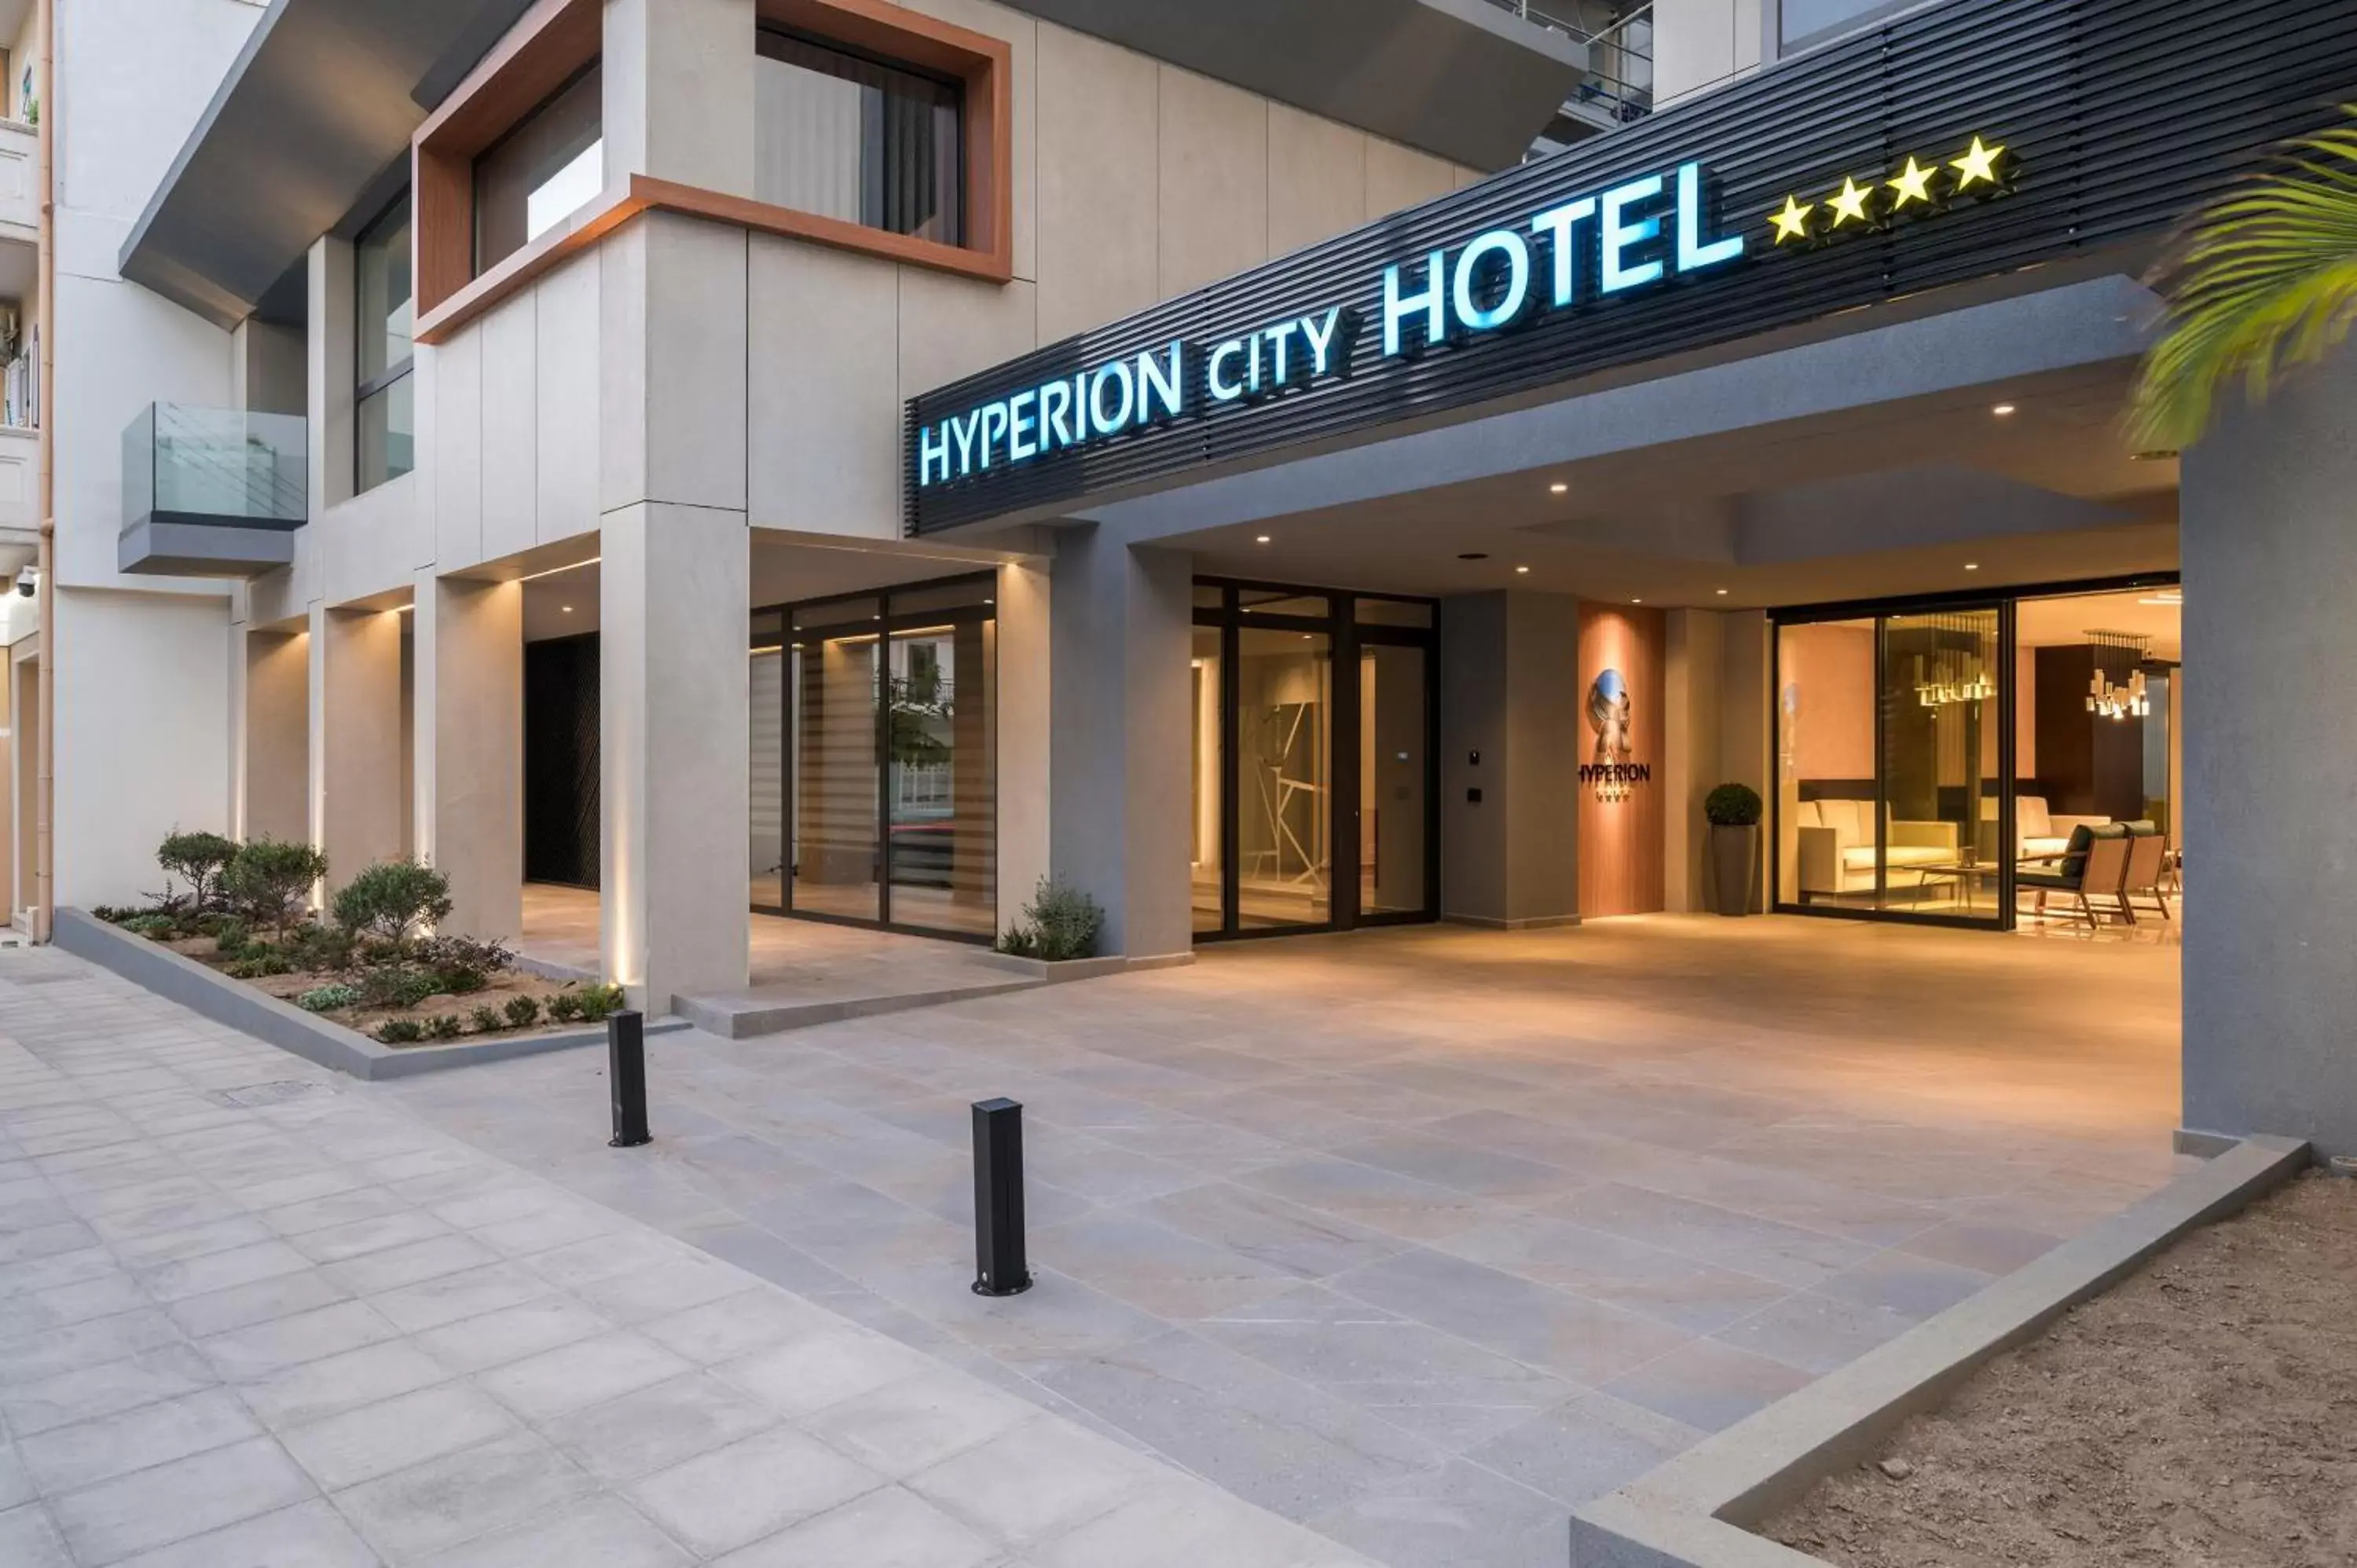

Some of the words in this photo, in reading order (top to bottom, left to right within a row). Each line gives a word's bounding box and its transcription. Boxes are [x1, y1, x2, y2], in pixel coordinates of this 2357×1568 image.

[920, 339, 1182, 487] HYPERION
[1208, 306, 1340, 401] CITY
[1382, 161, 1744, 357] HOTEL
